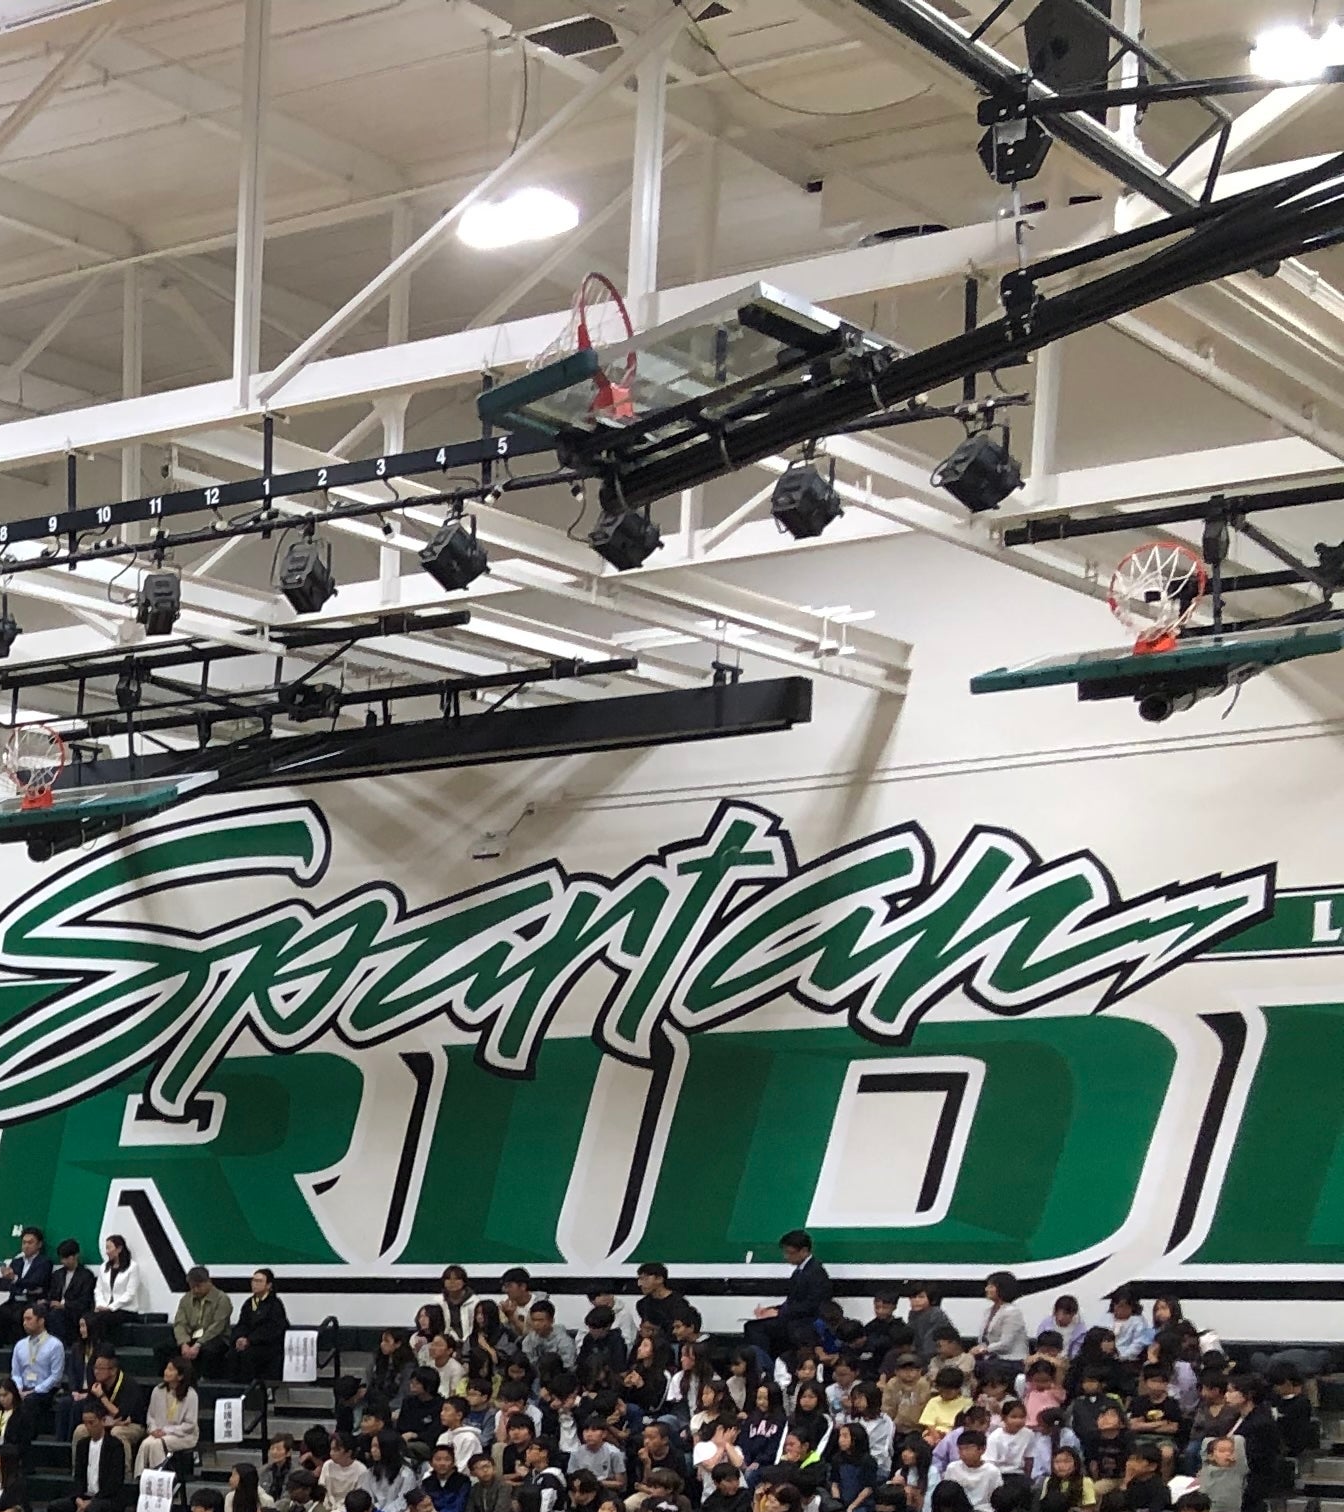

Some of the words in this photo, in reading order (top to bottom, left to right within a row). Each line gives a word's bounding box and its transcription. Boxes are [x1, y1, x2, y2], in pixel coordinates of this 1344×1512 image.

[0, 525, 8, 541] 8
[48, 516, 57, 532] 9
[96, 506, 111, 524] 10
[149, 498, 161, 515] 11
[205, 487, 220, 505] 12
